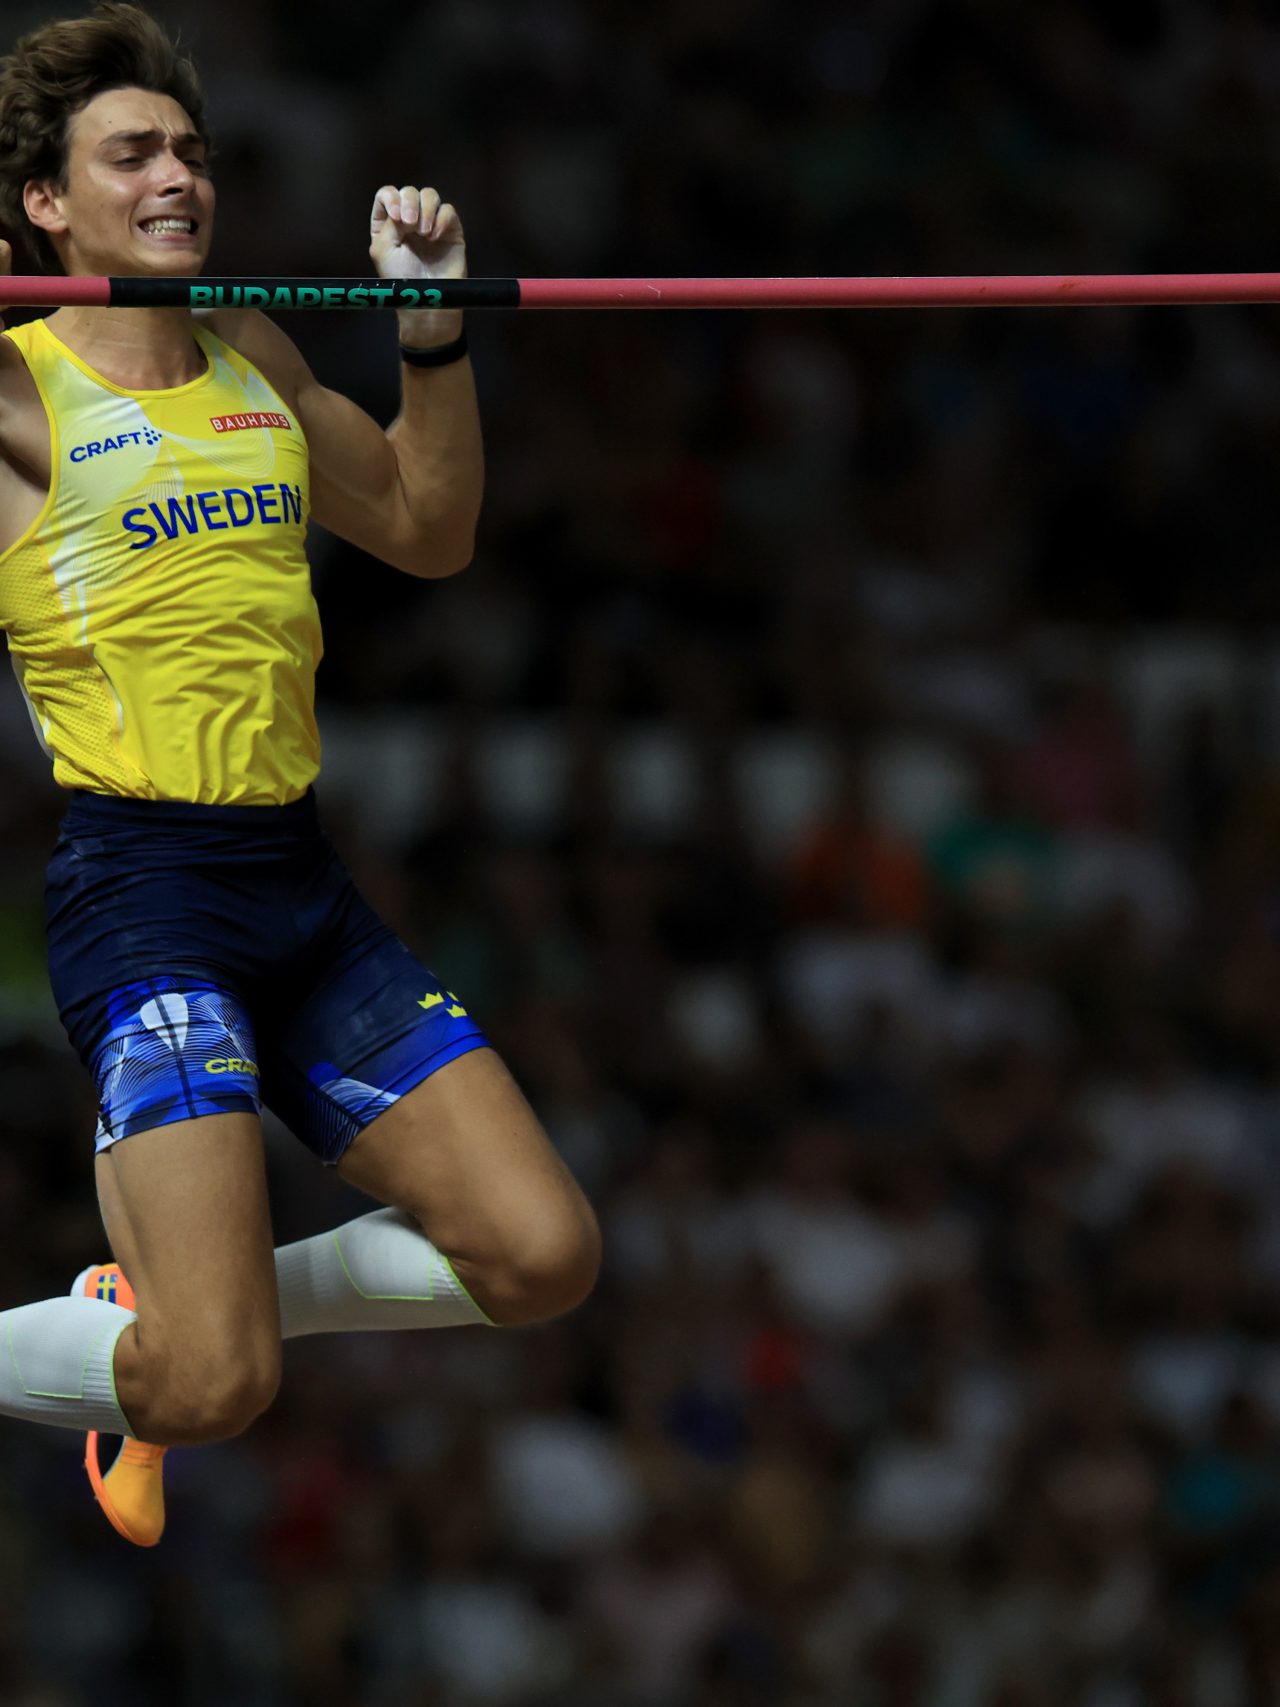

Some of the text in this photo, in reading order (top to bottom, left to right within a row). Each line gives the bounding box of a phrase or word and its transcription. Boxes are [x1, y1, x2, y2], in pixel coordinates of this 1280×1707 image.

[190, 286, 442, 308] BUDAPEST 23
[212, 414, 289, 431] BAUHAUS
[70, 432, 141, 463] CRAFT
[122, 484, 302, 550] SWEDEN
